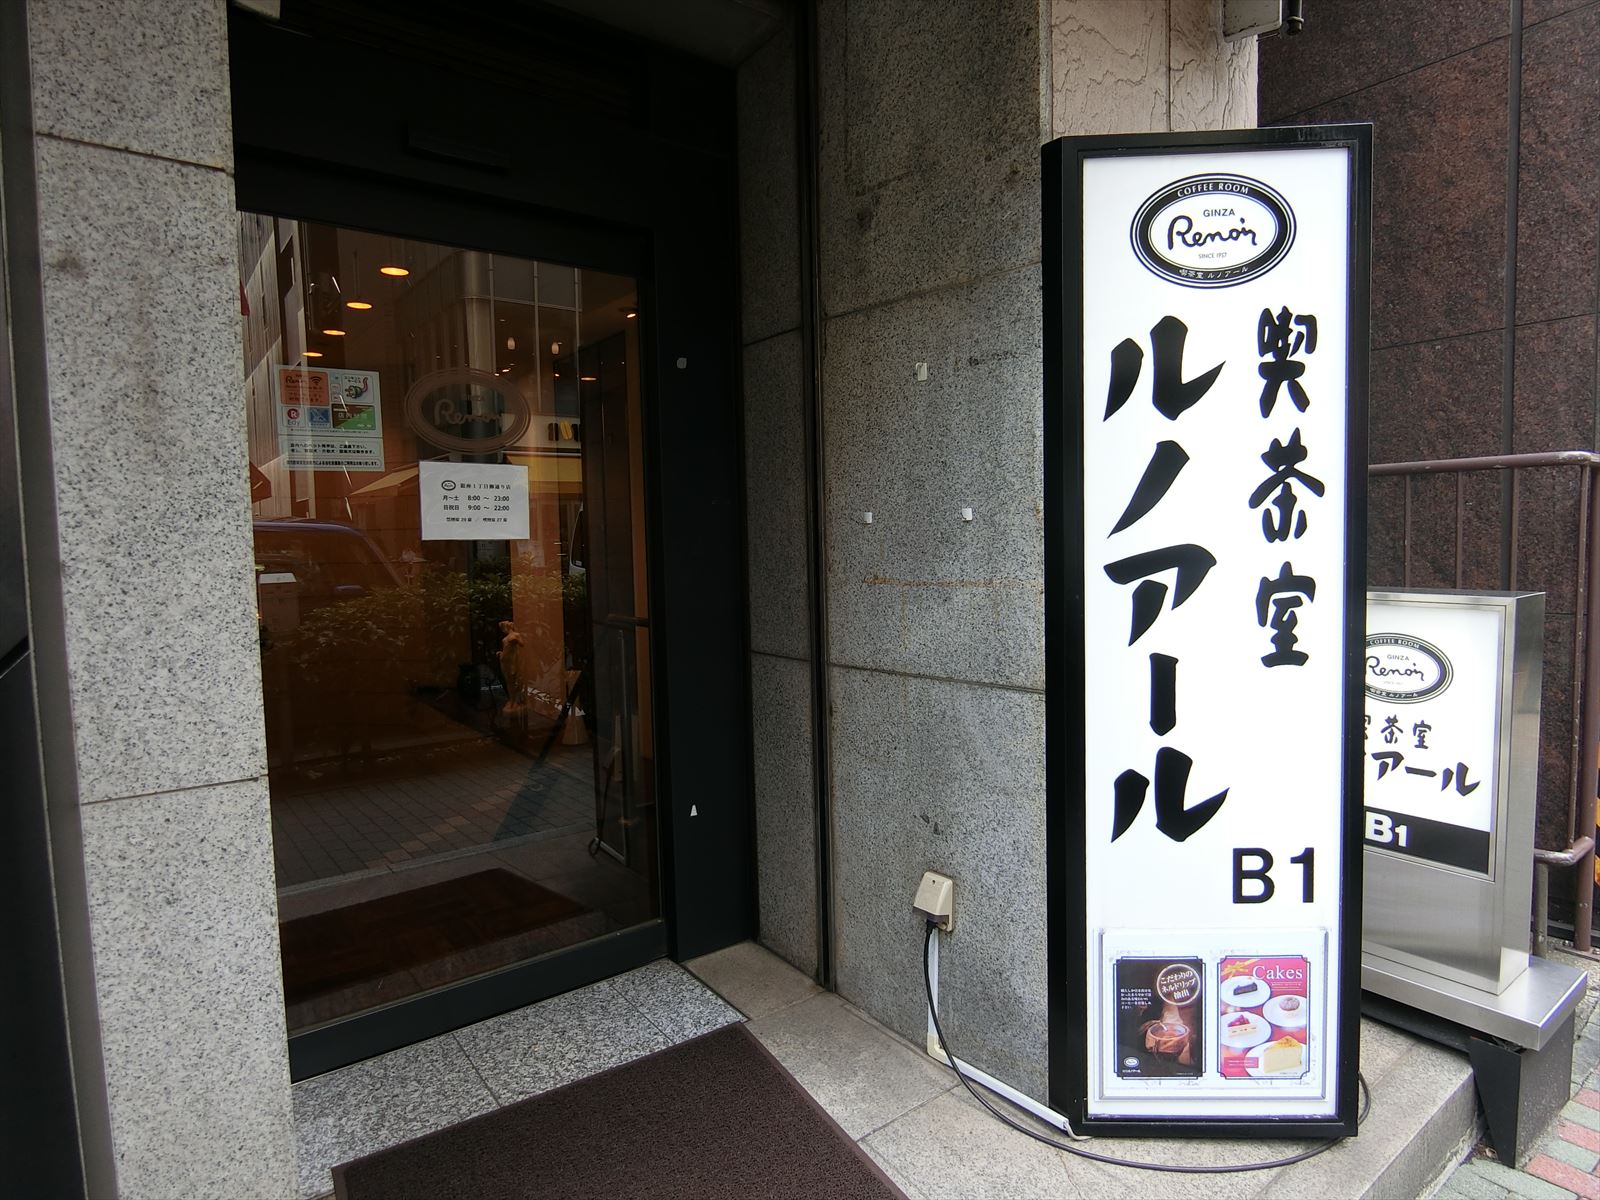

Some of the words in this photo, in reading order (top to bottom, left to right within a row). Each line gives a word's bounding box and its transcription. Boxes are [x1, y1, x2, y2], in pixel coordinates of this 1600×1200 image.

[1177, 183, 1214, 198] COFFEE
[1218, 183, 1249, 195] ROOM
[1203, 209, 1235, 217] GINZA
[1167, 215, 1258, 251] Renoir
[1207, 266, 1249, 279] ルノアール
[1248, 305, 1325, 668] 喫茶室
[467, 494, 481, 502] 8:00
[1103, 315, 1230, 842] ルノアール
[1398, 639, 1421, 649] ROOM
[1386, 653, 1410, 661] GINZA
[1366, 655, 1424, 681] Renoir
[1365, 811, 1408, 848] B1
[1232, 847, 1315, 904] B1
[1160, 970, 1194, 984] こだわりの
[1252, 965, 1303, 980] Cakes
[1161, 977, 1197, 993] ネルドリップ
